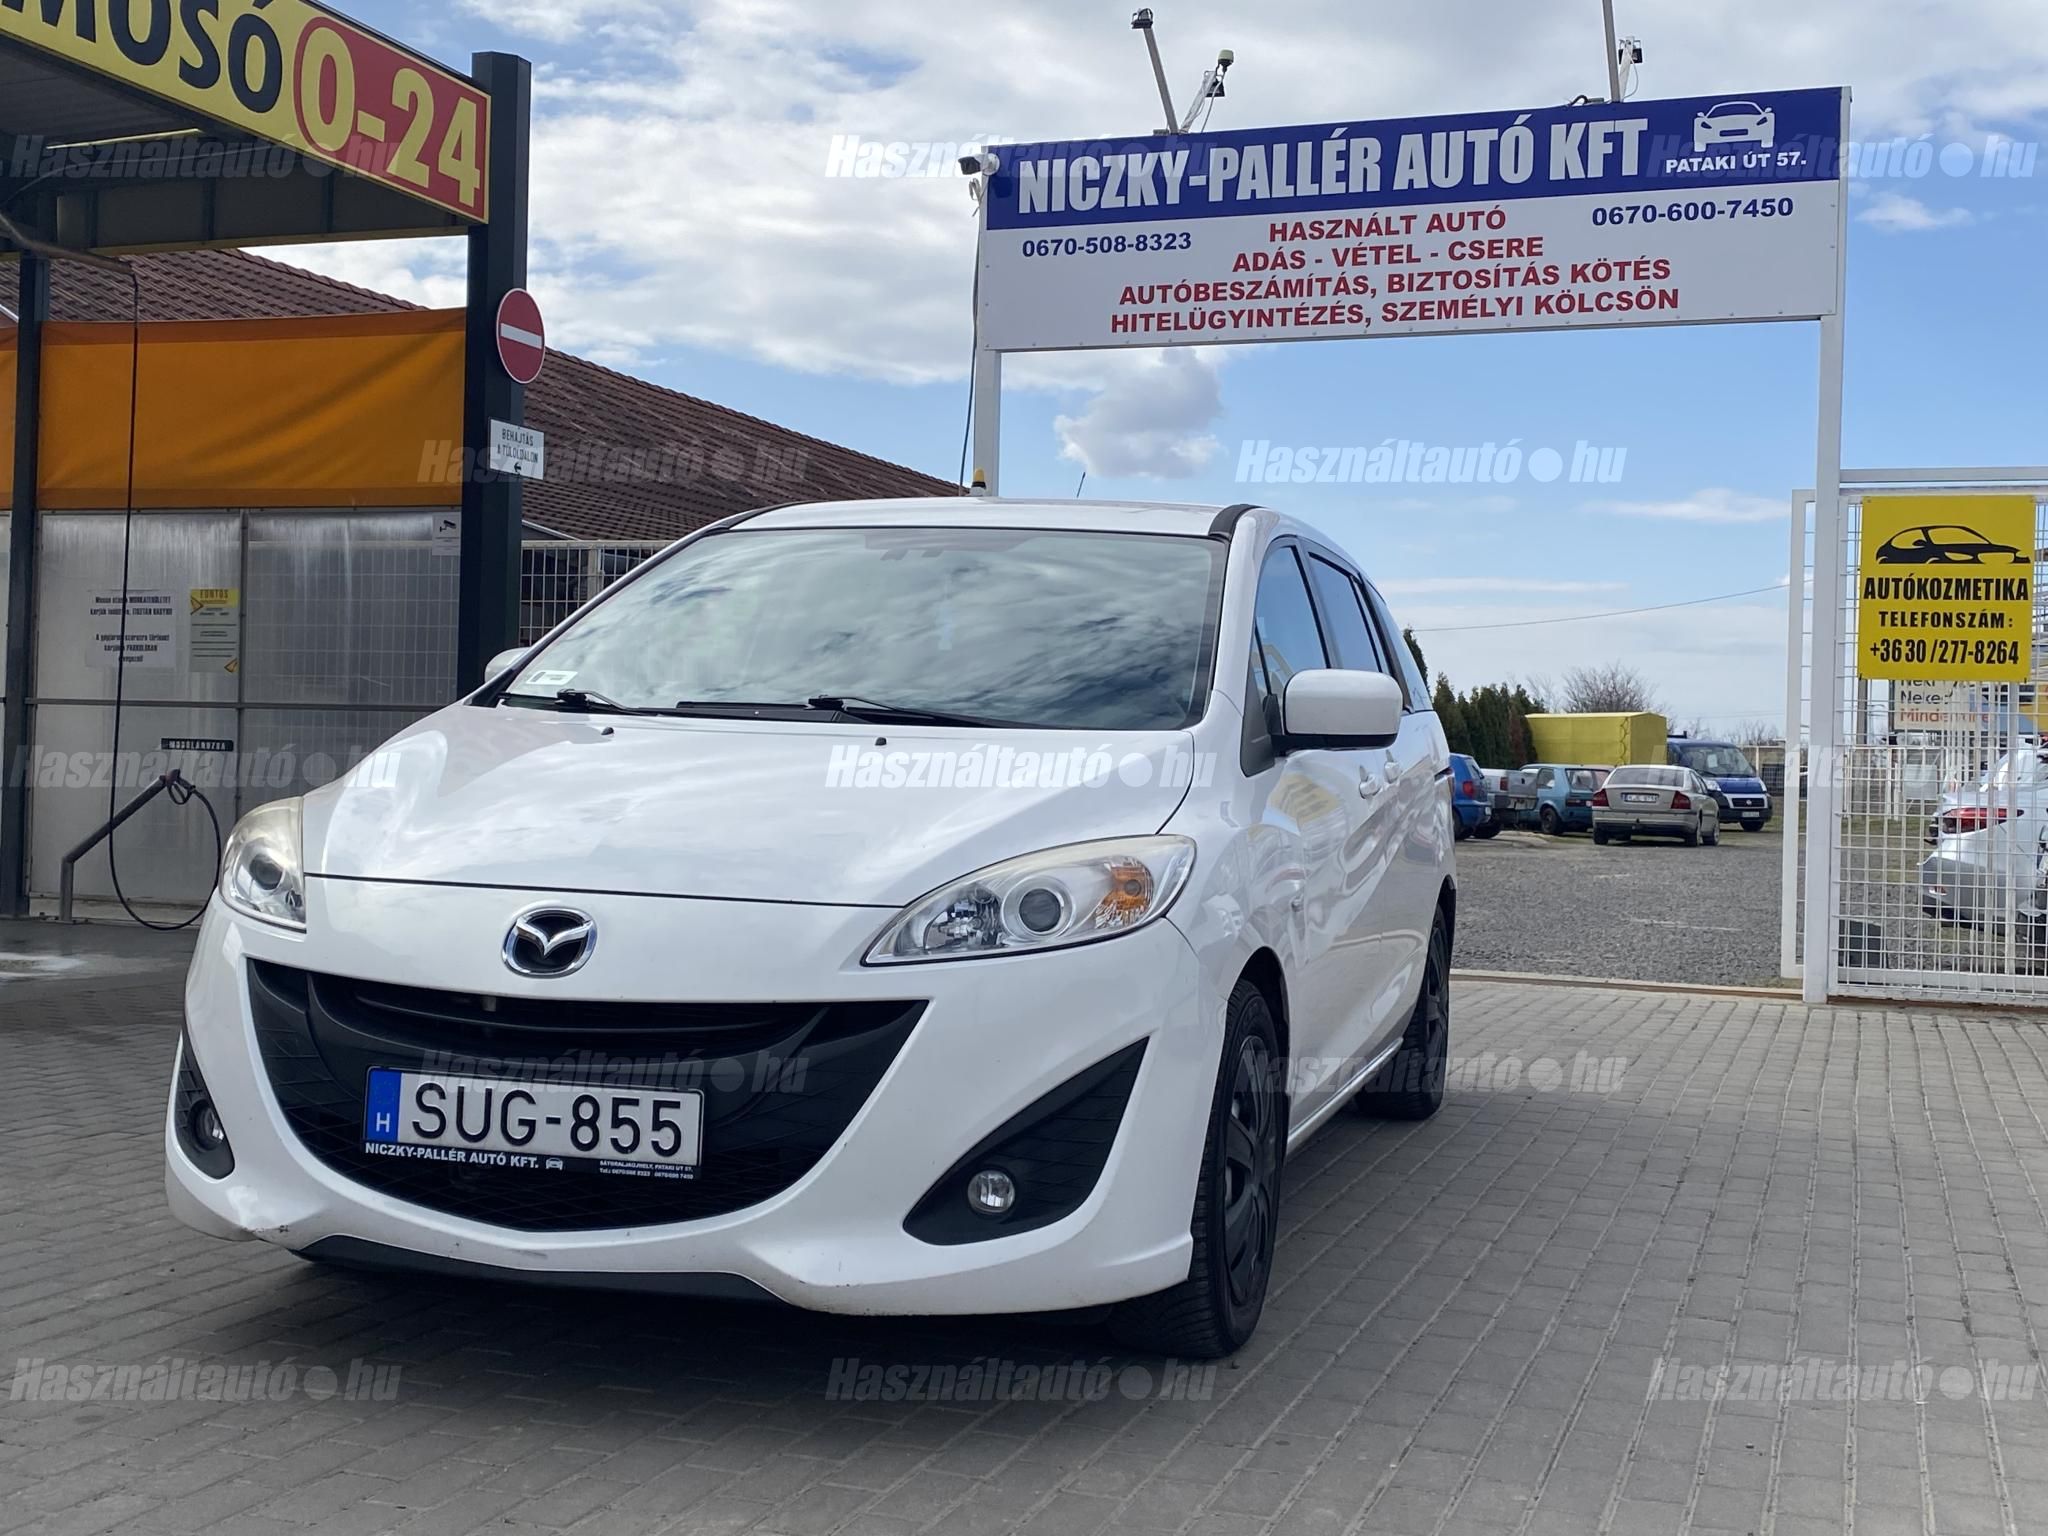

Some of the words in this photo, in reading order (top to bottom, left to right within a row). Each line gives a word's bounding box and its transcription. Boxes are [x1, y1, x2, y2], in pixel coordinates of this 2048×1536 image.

[300, 26, 481, 208] 0-24
[1018, 127, 1383, 214] NICZKY-PALLÉR
[1392, 113, 1535, 190] AUTÓ
[1549, 117, 1649, 181] KFT
[1665, 156, 1736, 174] PATAKI
[1743, 151, 1771, 169] ÚT
[1776, 151, 1807, 168] 57.
[1269, 211, 1418, 243] HASZNÁLT
[1425, 204, 1507, 234] AUTÓ
[1591, 197, 1795, 226] 0670-600-7450
[1022, 231, 1193, 257] 0670-508-8323
[1232, 246, 1307, 273] ADÁS
[1331, 241, 1422, 268] VÉTEL
[1448, 236, 1544, 262] CSERE
[1119, 271, 1377, 306] AUTÓBESZÁMÍTÁS,
[1387, 260, 1560, 294] BIZTOSÍTÁS
[1570, 254, 1672, 285] KÖTÉS
[1111, 300, 1372, 334] HITELÜGYINTÉZÉS,
[1381, 293, 1524, 323] SZEMÉLYI
[1534, 285, 1680, 316] KÖLCSÖN
[501, 428, 534, 447] BEHAJTÁS
[1863, 573, 2029, 601] AUTÓKOZMETIKA
[375, 1112, 391, 1133] H
[411, 1082, 682, 1157] SUG-855
[364, 1142, 466, 1163] NICZKY-PALLÉR
[469, 1151, 507, 1166] AUTÓ
[510, 1156, 539, 1169] KFT.
